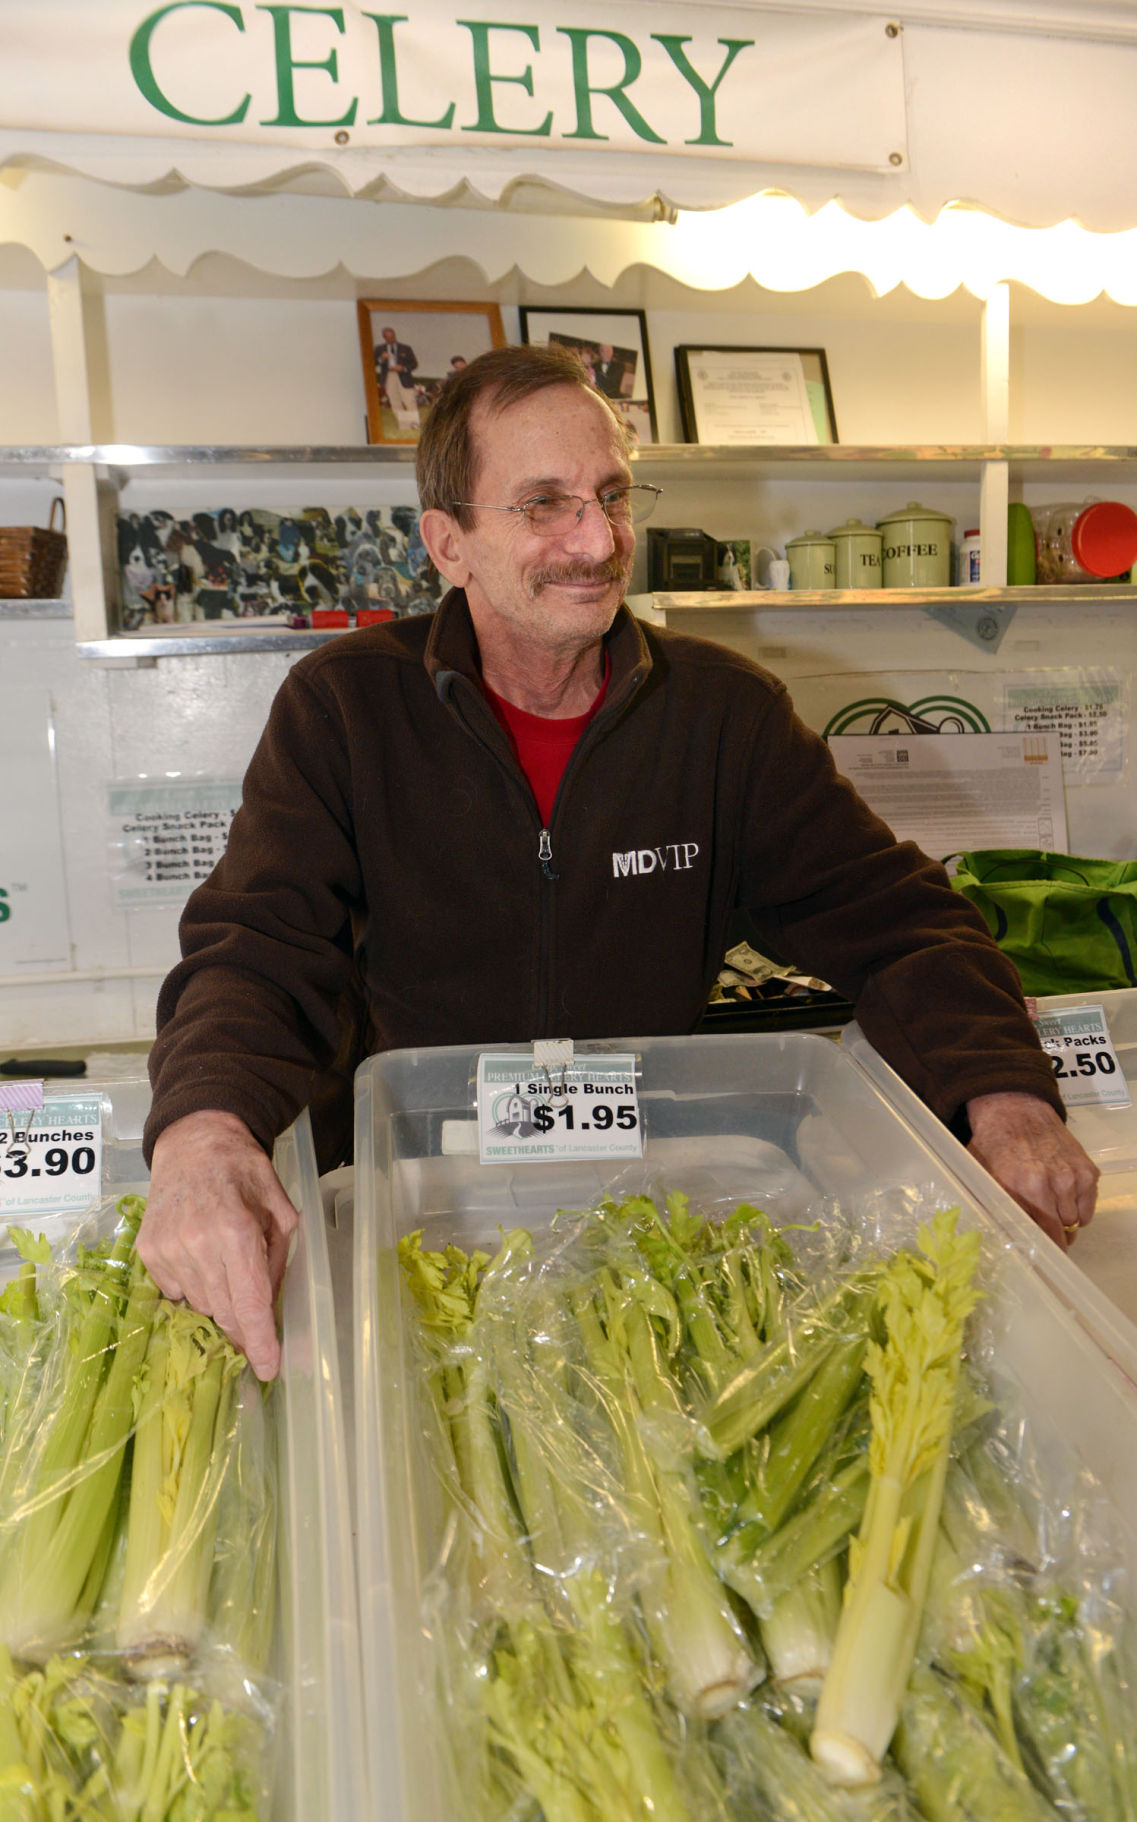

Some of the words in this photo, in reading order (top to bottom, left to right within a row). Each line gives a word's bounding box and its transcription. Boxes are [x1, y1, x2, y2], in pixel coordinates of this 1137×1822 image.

[129, 1, 755, 147] CELERY
[1024, 706, 1053, 715] Cooking
[1055, 705, 1078, 714] Celery
[1014, 714, 1038, 722] Celery
[1041, 713, 1062, 721] Snack
[1065, 711, 1082, 719] Pack
[1033, 722, 1056, 730] Bunch
[1058, 722, 1072, 731] Bag
[135, 813, 181, 823] Cooking
[184, 811, 219, 821] Celery
[122, 824, 158, 834] Celery
[163, 822, 196, 831] Snack
[200, 820, 226, 829] Pack
[153, 835, 187, 844] Bunch
[191, 834, 212, 843] Bag
[145, 849, 150, 857] 2
[154, 847, 188, 857] Bunch
[192, 846, 213, 855] Bag
[146, 861, 152, 870] 3
[156, 860, 190, 870] Bunch
[193, 859, 214, 868] Bag
[612, 843, 699, 878] MDVIP
[156, 872, 190, 882] Bunch
[1063, 1023, 1102, 1035] HEARTS
[1064, 1035, 1107, 1048] Packs
[1051, 1051, 1116, 1079] 2.50
[487, 1071, 539, 1082] PREMIUM
[588, 1072, 631, 1082] HEARTS
[527, 1083, 579, 1097] Single
[583, 1083, 635, 1095] Bunch
[48, 1114, 97, 1126] HEARTS
[533, 1104, 638, 1134] $1.95
[14, 1130, 95, 1144] Bunches
[485, 1144, 555, 1156] SWEETHEARTS
[608, 1143, 637, 1153] County
[0, 1147, 96, 1178] 3.90
